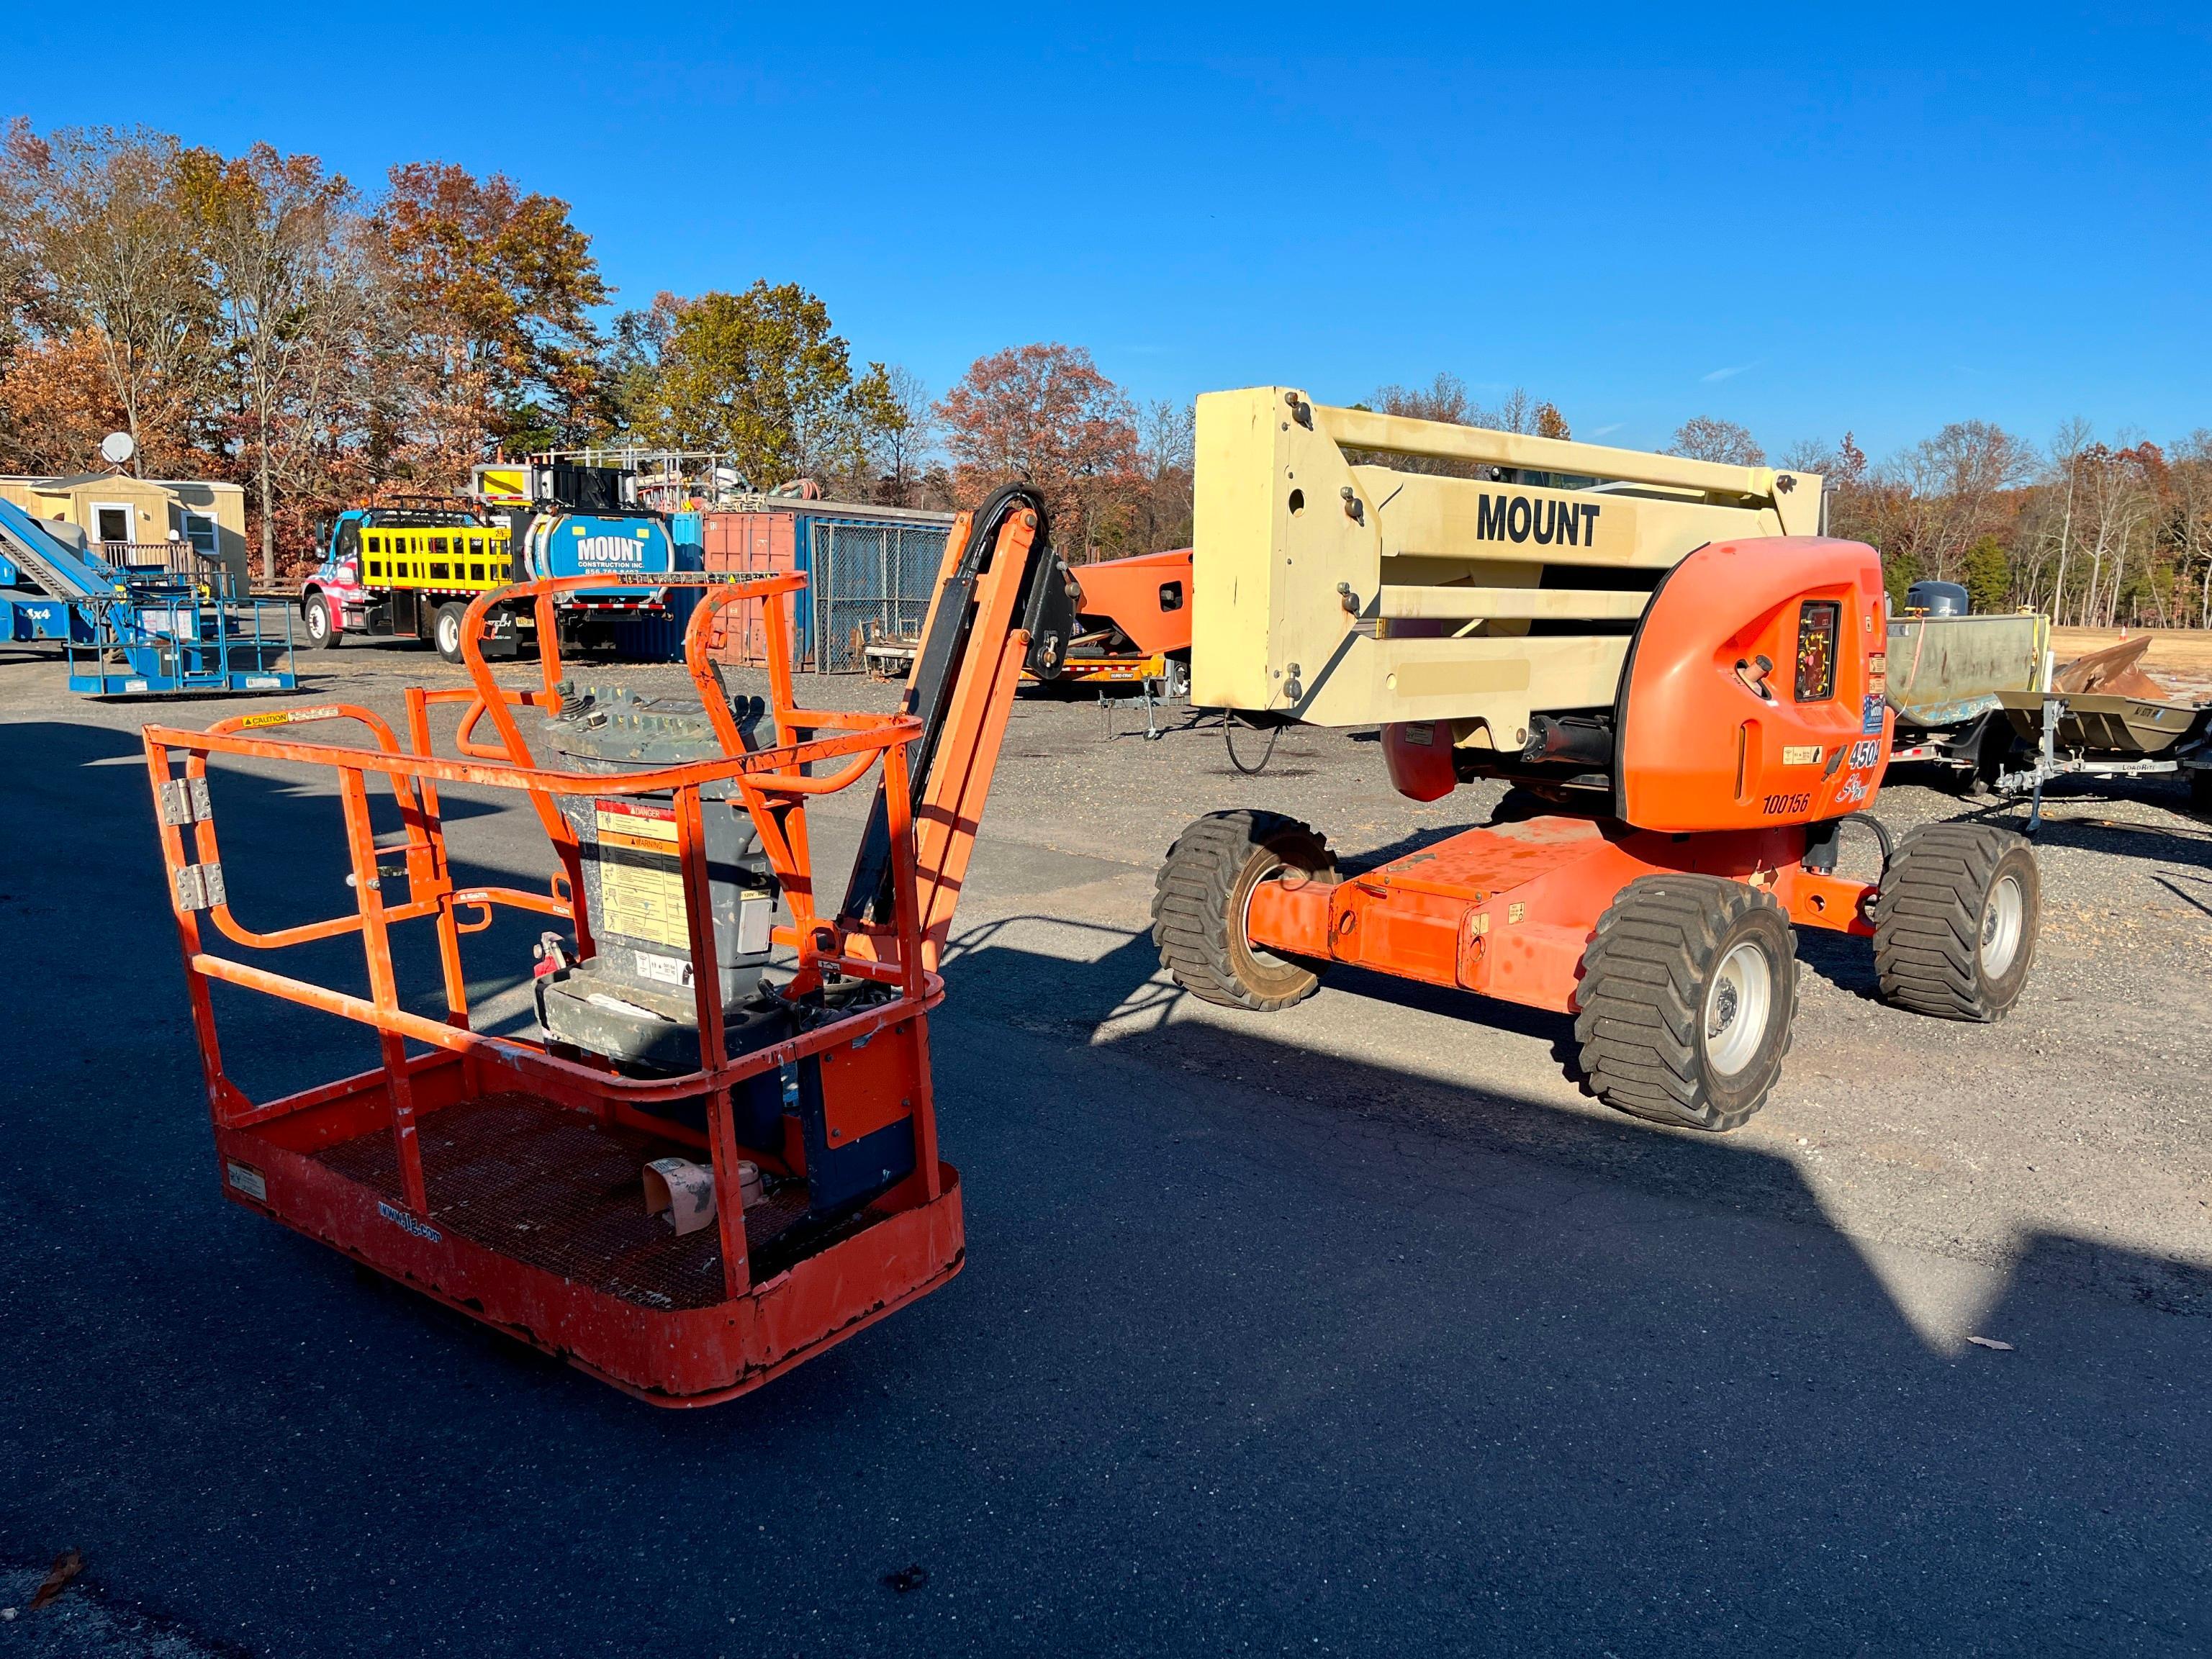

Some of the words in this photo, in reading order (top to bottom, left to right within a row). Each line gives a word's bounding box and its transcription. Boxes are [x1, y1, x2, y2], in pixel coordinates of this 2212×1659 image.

[1477, 494, 1600, 547] MOUNT
[577, 536, 644, 561] MOUNT
[24, 608, 51, 620] 4x4
[253, 714, 286, 724] CAUTION
[1763, 793, 1810, 814] 100156
[636, 808, 660, 818] DANGER
[636, 838, 662, 850] WARNING
[378, 1201, 442, 1243] www.jlg.com
